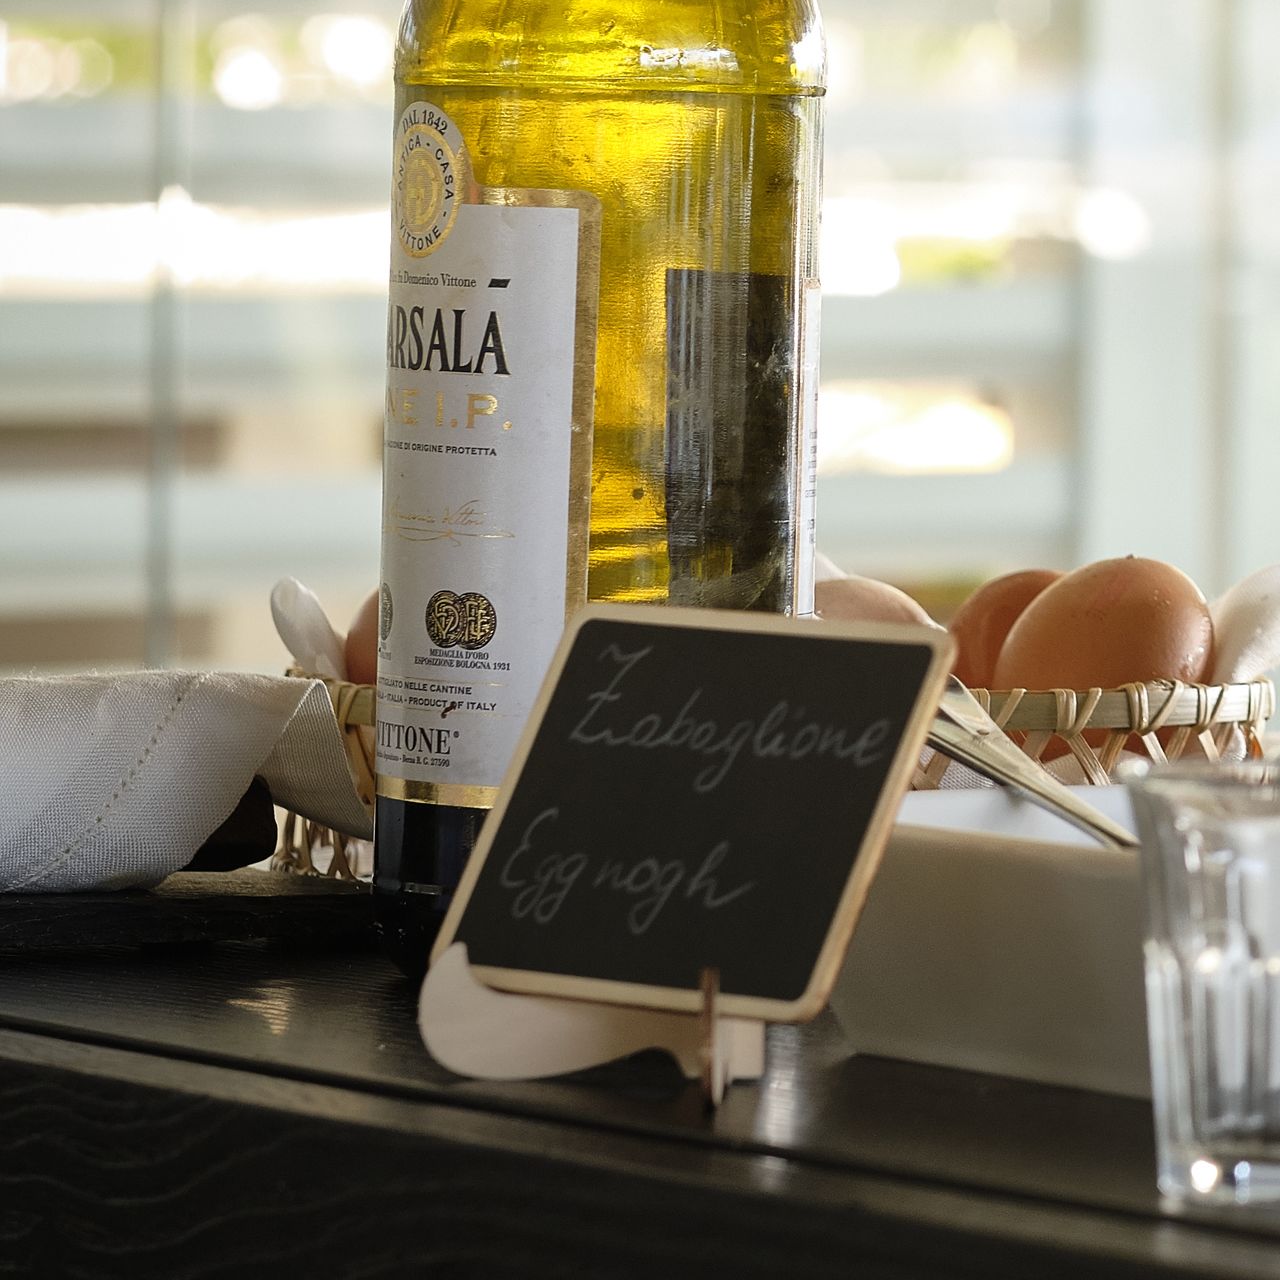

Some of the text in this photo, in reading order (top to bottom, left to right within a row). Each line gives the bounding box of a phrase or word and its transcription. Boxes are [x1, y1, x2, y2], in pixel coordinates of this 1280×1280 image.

[402, 109, 448, 136] DAL 1842
[435, 148, 455, 200] CASA
[399, 218, 442, 251] VITTONE
[404, 271, 439, 286] Domenico
[440, 273, 477, 288] Vittone
[411, 443, 444, 453] ORIGINE
[445, 445, 498, 457] PROTETTA
[429, 648, 490, 661] MEDAGLIA D'ORO
[414, 656, 511, 671] ESPOSIZIONE BOLOGNA 1931
[404, 682, 428, 692] NELLE
[429, 684, 472, 695] CANTINE
[408, 696, 448, 709] PRODUCT
[466, 702, 497, 711] ITALY
